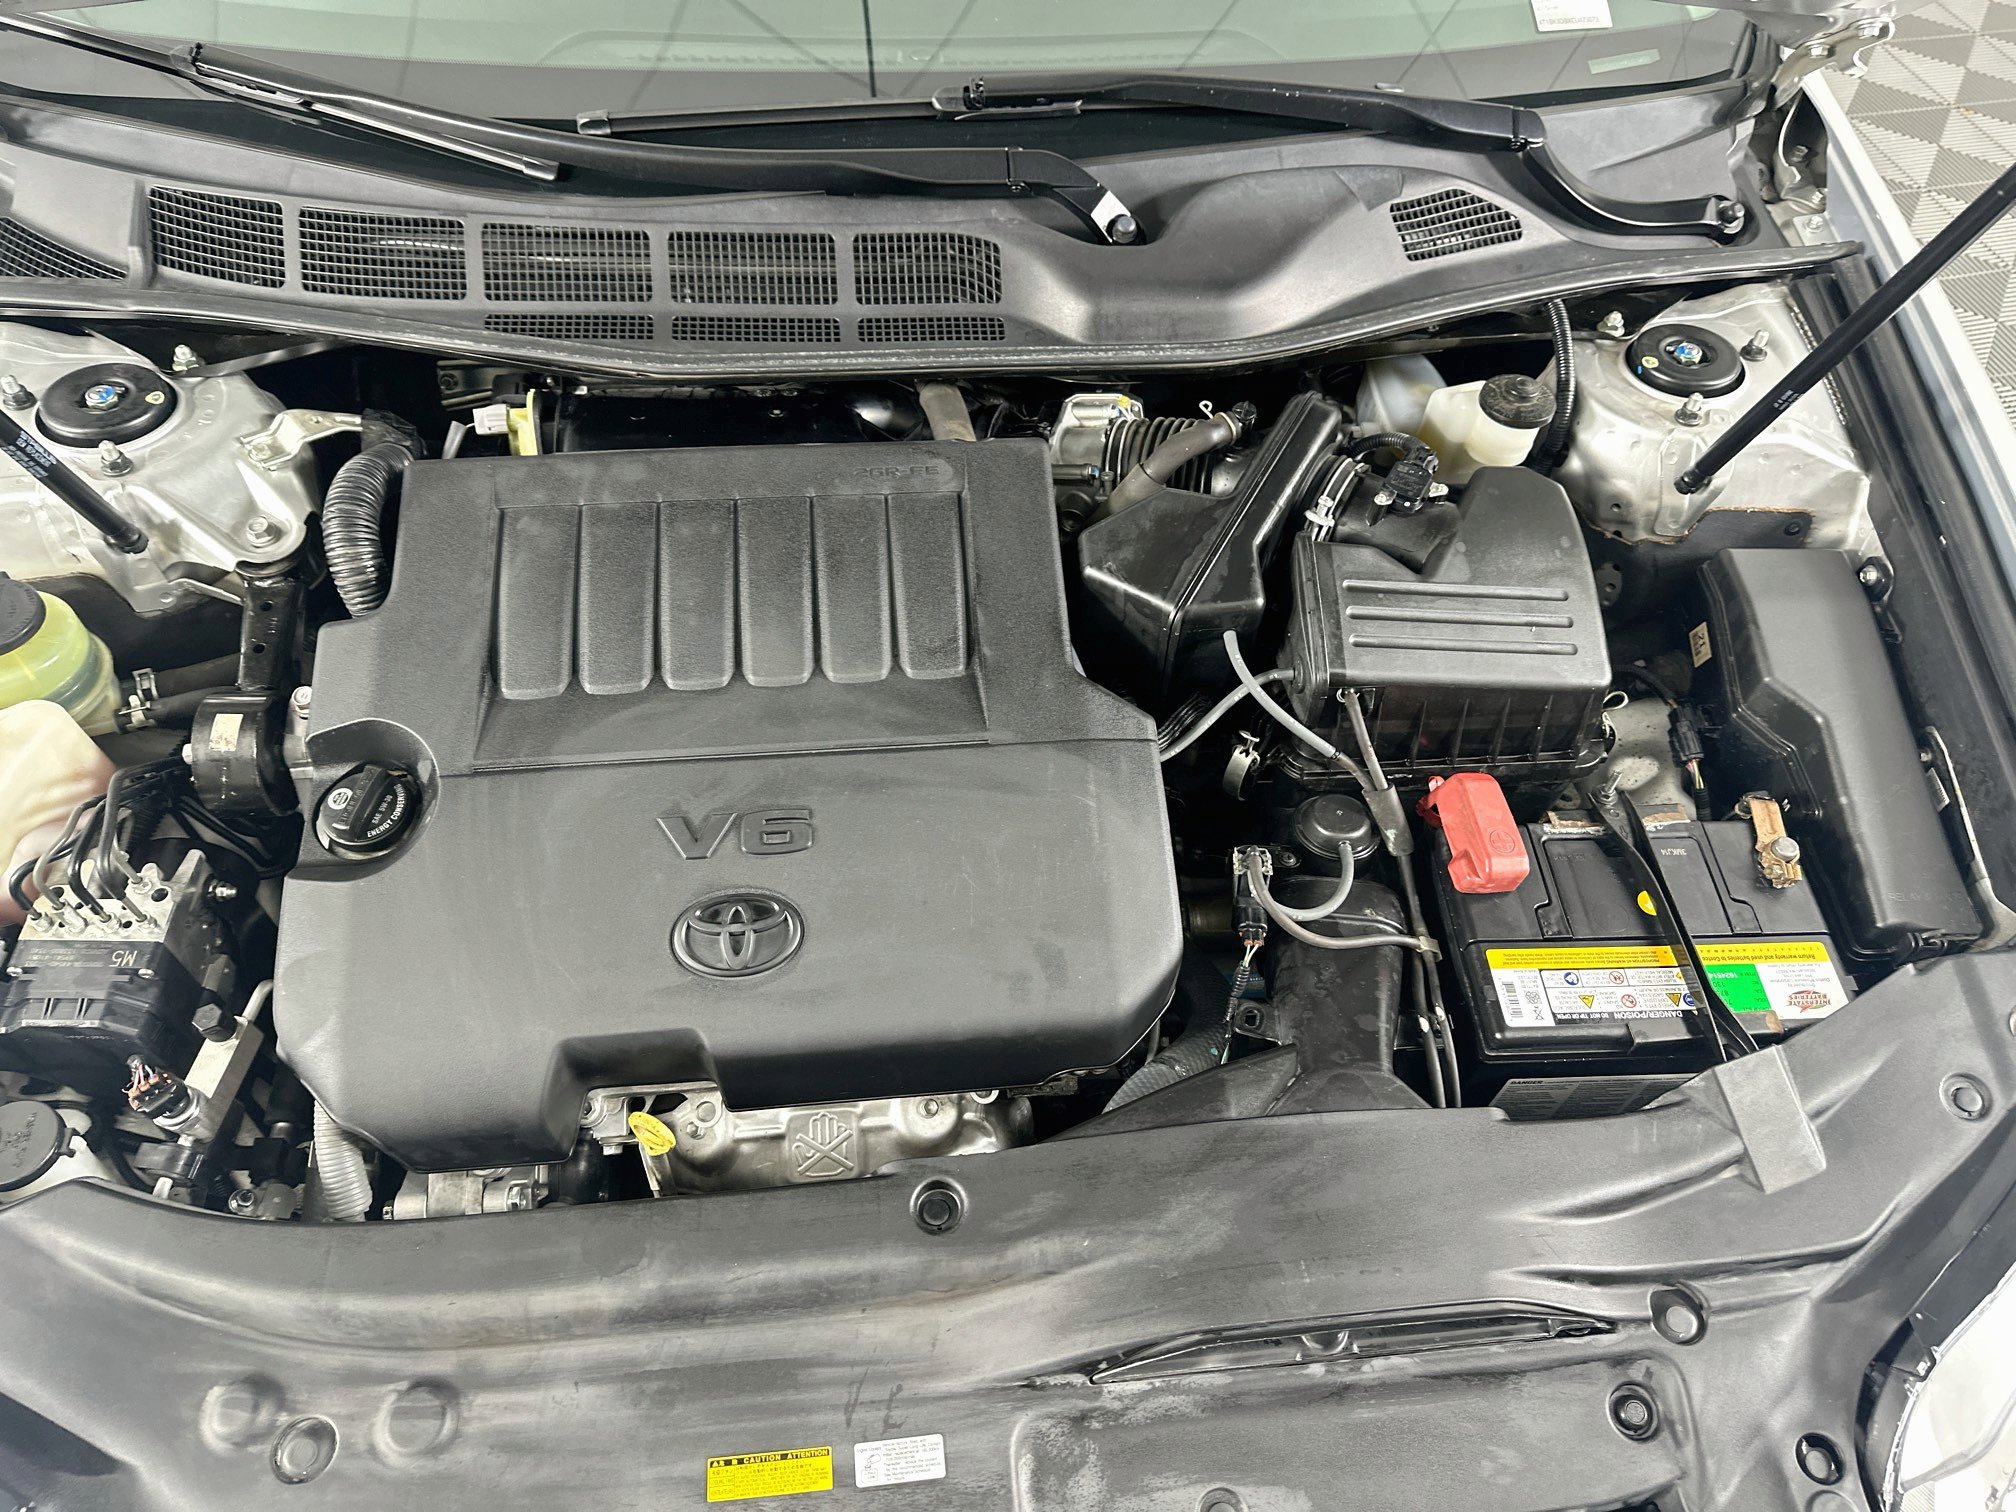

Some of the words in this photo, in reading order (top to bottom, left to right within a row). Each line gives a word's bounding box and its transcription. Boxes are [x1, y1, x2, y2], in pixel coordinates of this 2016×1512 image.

[853, 465, 940, 479] 2GR-FE
[372, 813, 383, 824] SAE
[367, 819, 393, 838] ENERGY
[656, 808, 813, 860] V6
[109, 950, 137, 967] M5
[1786, 998, 1831, 1006] INTERSTATE
[1613, 1010, 1683, 1019] DANGER/POISON
[743, 1455, 781, 1464] CAUTION
[787, 1449, 829, 1459] ATTENTION
